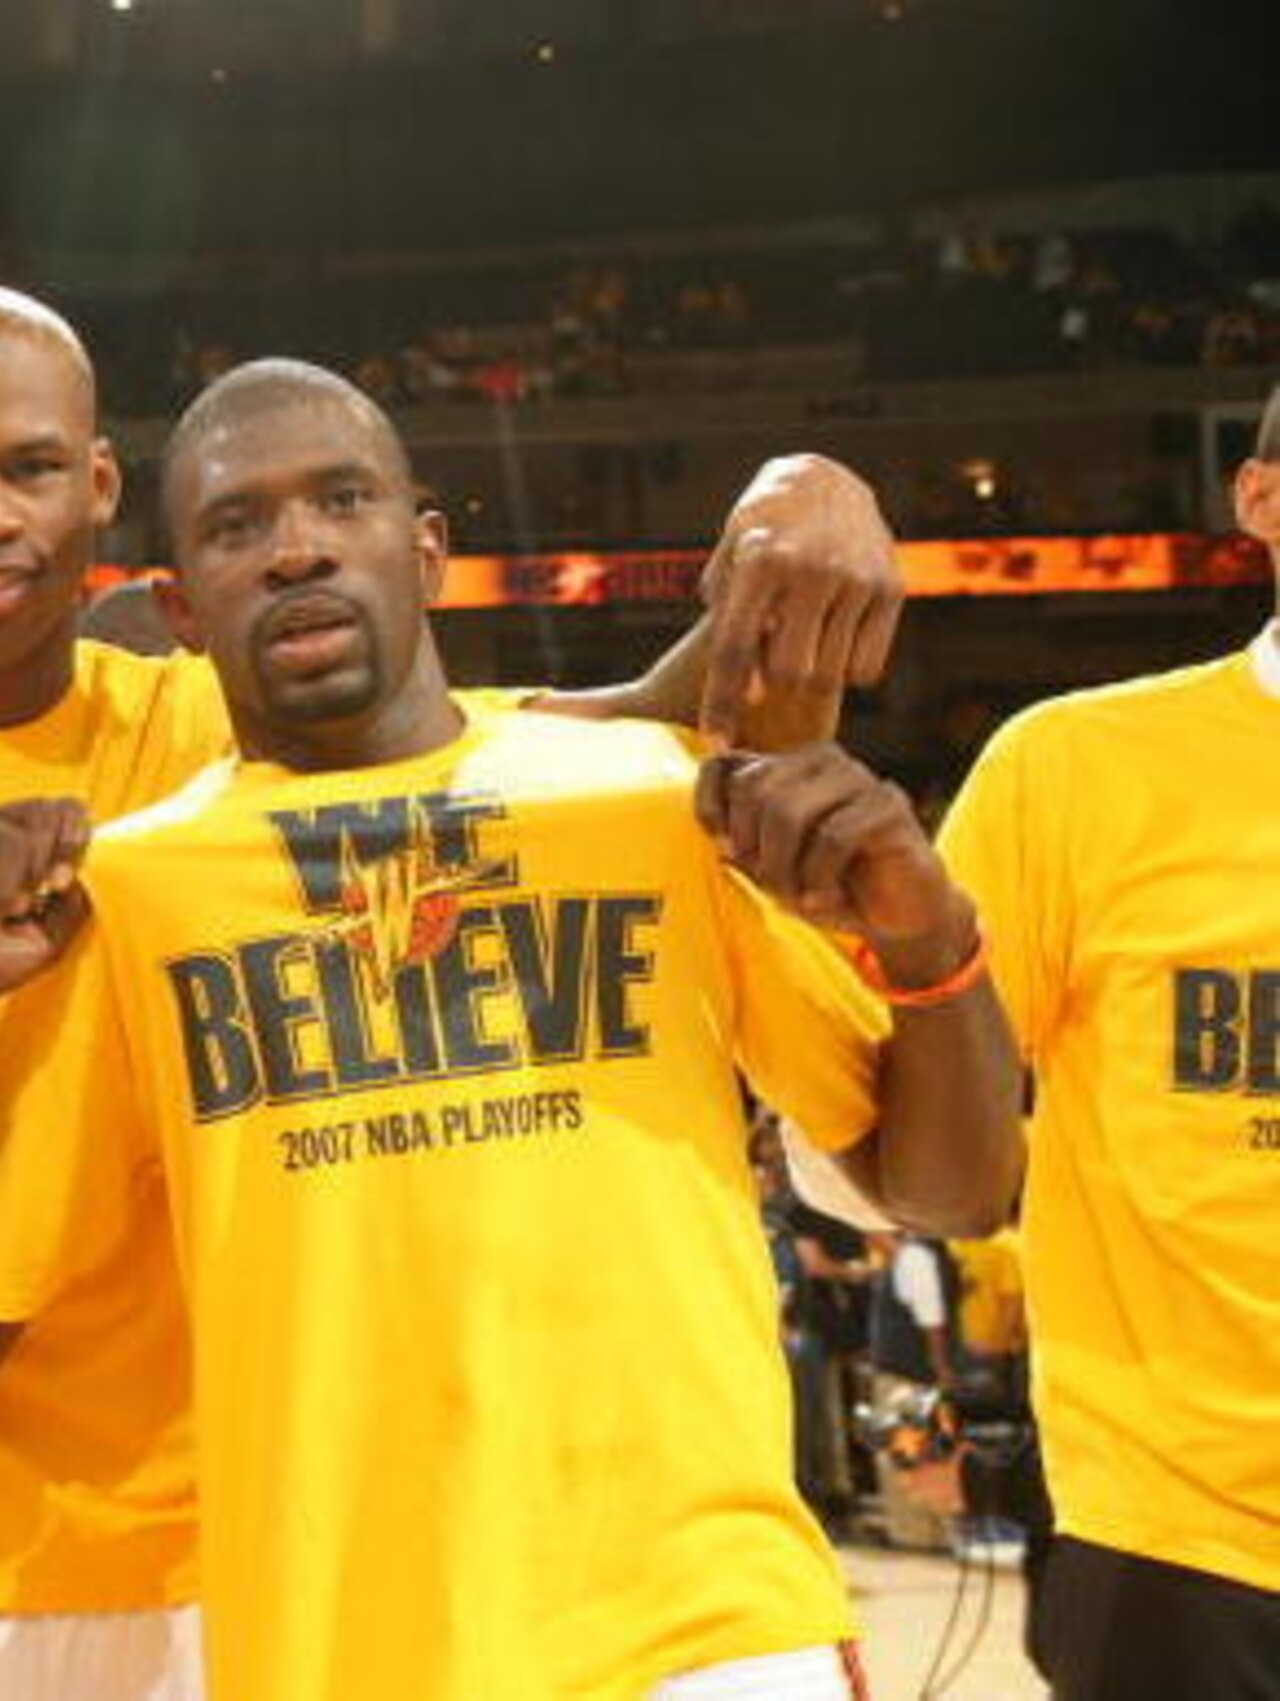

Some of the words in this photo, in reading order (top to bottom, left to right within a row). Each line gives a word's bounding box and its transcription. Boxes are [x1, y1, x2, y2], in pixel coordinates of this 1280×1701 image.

[265, 790, 519, 915] WE
[162, 893, 663, 1124] BELIEVE
[279, 1123, 355, 1172] 2007
[366, 1110, 432, 1156] NBA
[441, 1089, 583, 1146] PLAYOFFS
